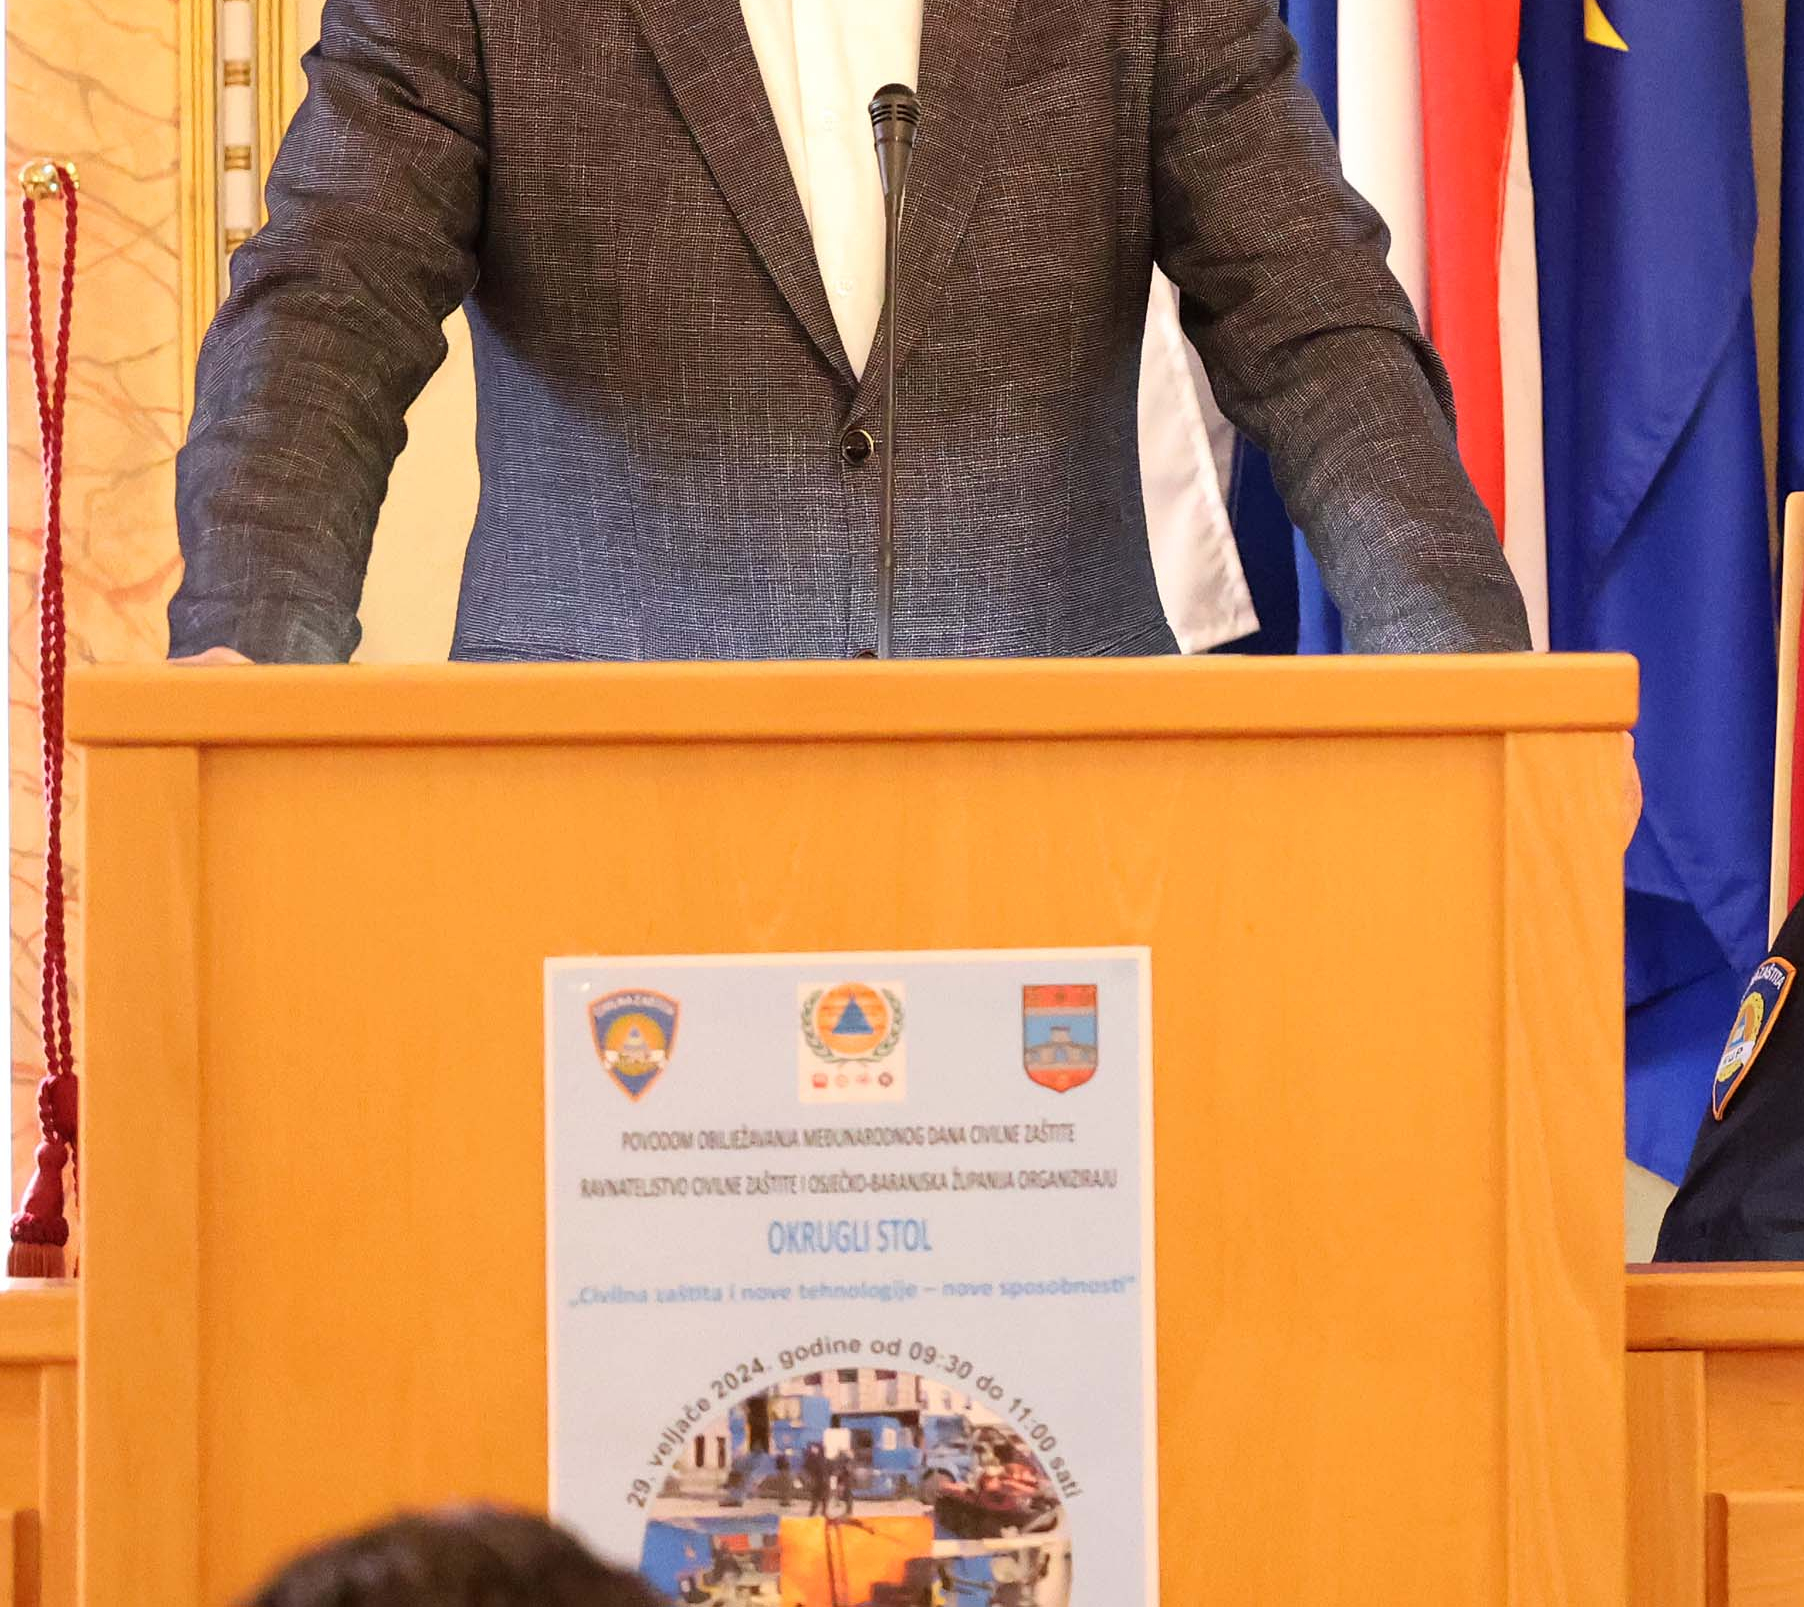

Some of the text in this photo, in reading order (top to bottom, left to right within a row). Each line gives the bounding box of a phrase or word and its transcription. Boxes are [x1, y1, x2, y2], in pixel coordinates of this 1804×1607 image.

[768, 1219, 932, 1254] OKRUGLI STOL
[648, 1397, 711, 1466] veljače
[710, 1357, 773, 1399] 2024.
[778, 1336, 861, 1370] godine
[870, 1339, 901, 1357] od
[909, 1341, 974, 1380] 09:30
[976, 1373, 1004, 1401] do
[1008, 1397, 1057, 1453] 11:00
[1049, 1456, 1083, 1498] sati
